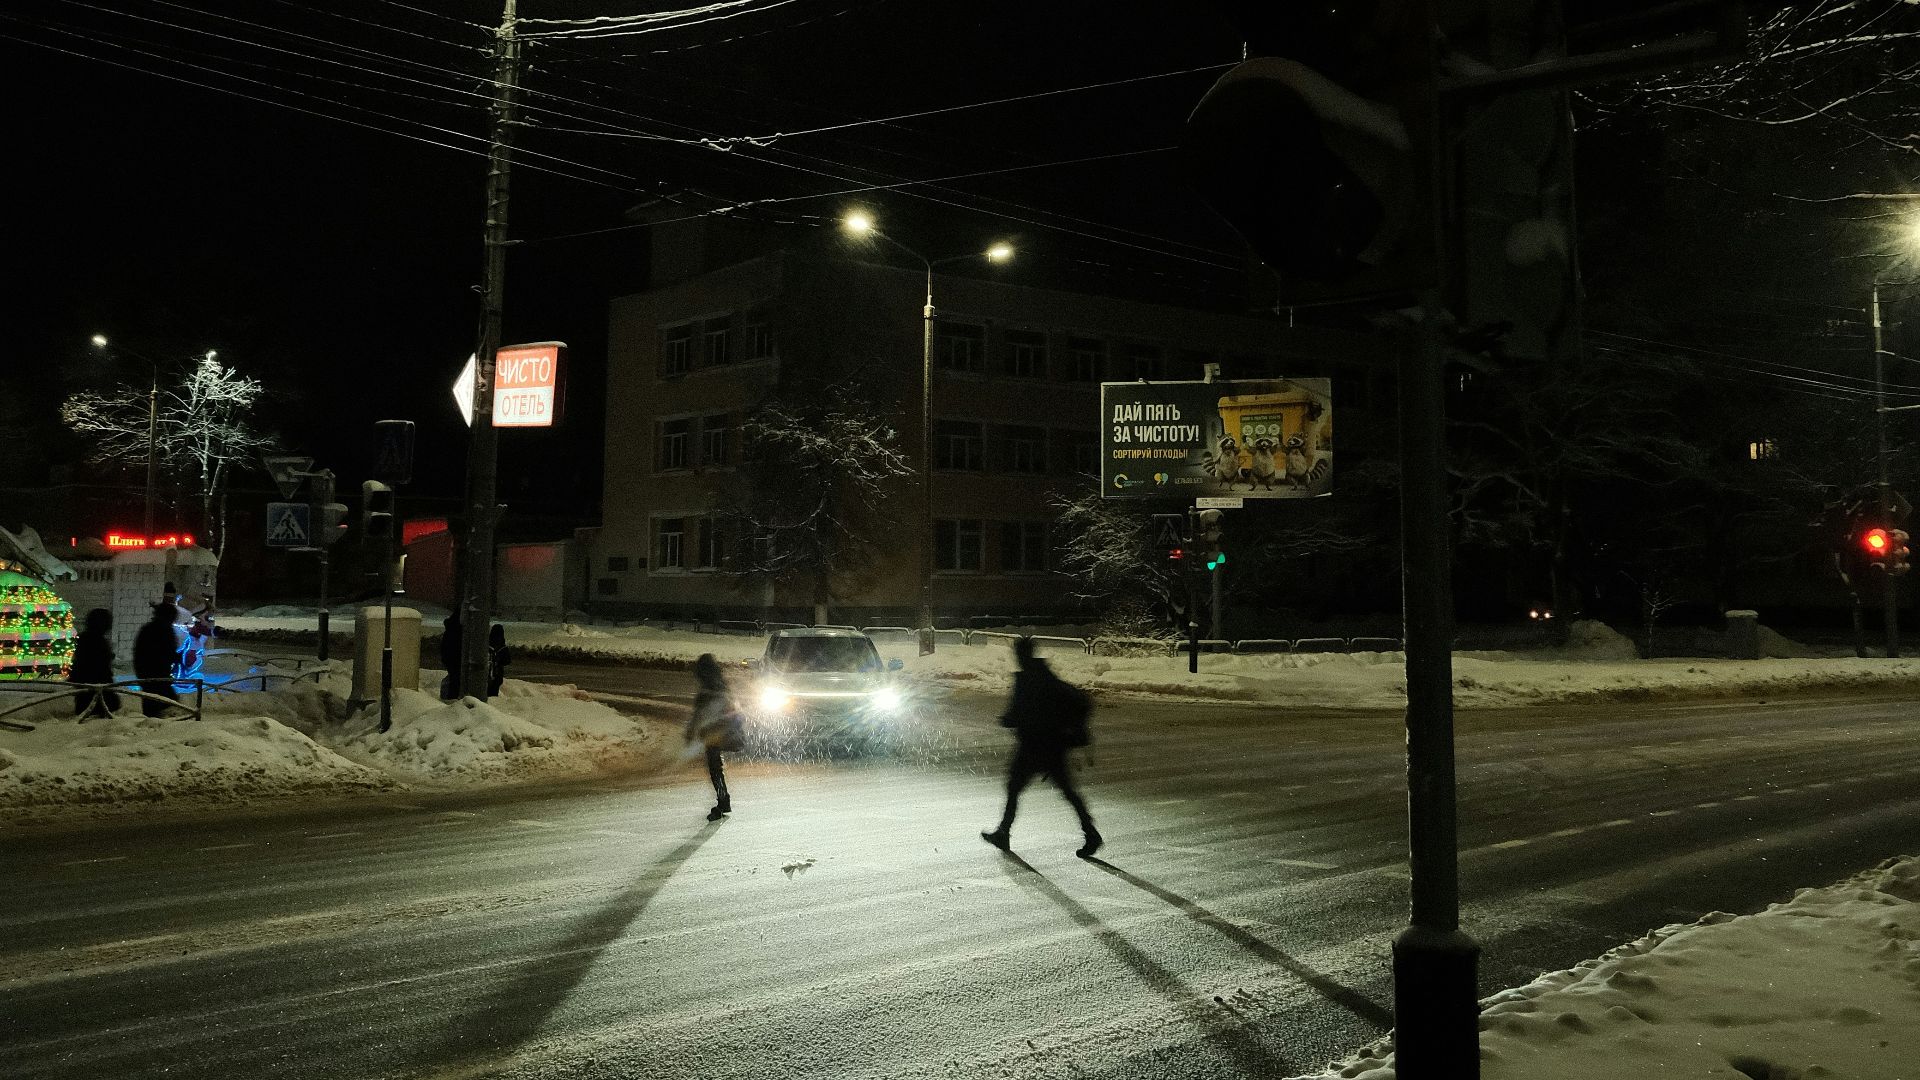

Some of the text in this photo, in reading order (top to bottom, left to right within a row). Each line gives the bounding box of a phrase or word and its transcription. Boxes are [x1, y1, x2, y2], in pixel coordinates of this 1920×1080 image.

[498, 356, 551, 384] ЧИСТО
[502, 395, 545, 417] ОТЕЛЬ
[1112, 401, 1181, 423] ДАЙ ПЯТЬ
[1113, 424, 1200, 443] ЗА ЧИСТОТУ!
[1112, 447, 1188, 460] СОРТИРУЙ ОТХОДЫ!
[109, 535, 146, 546] Плитк
